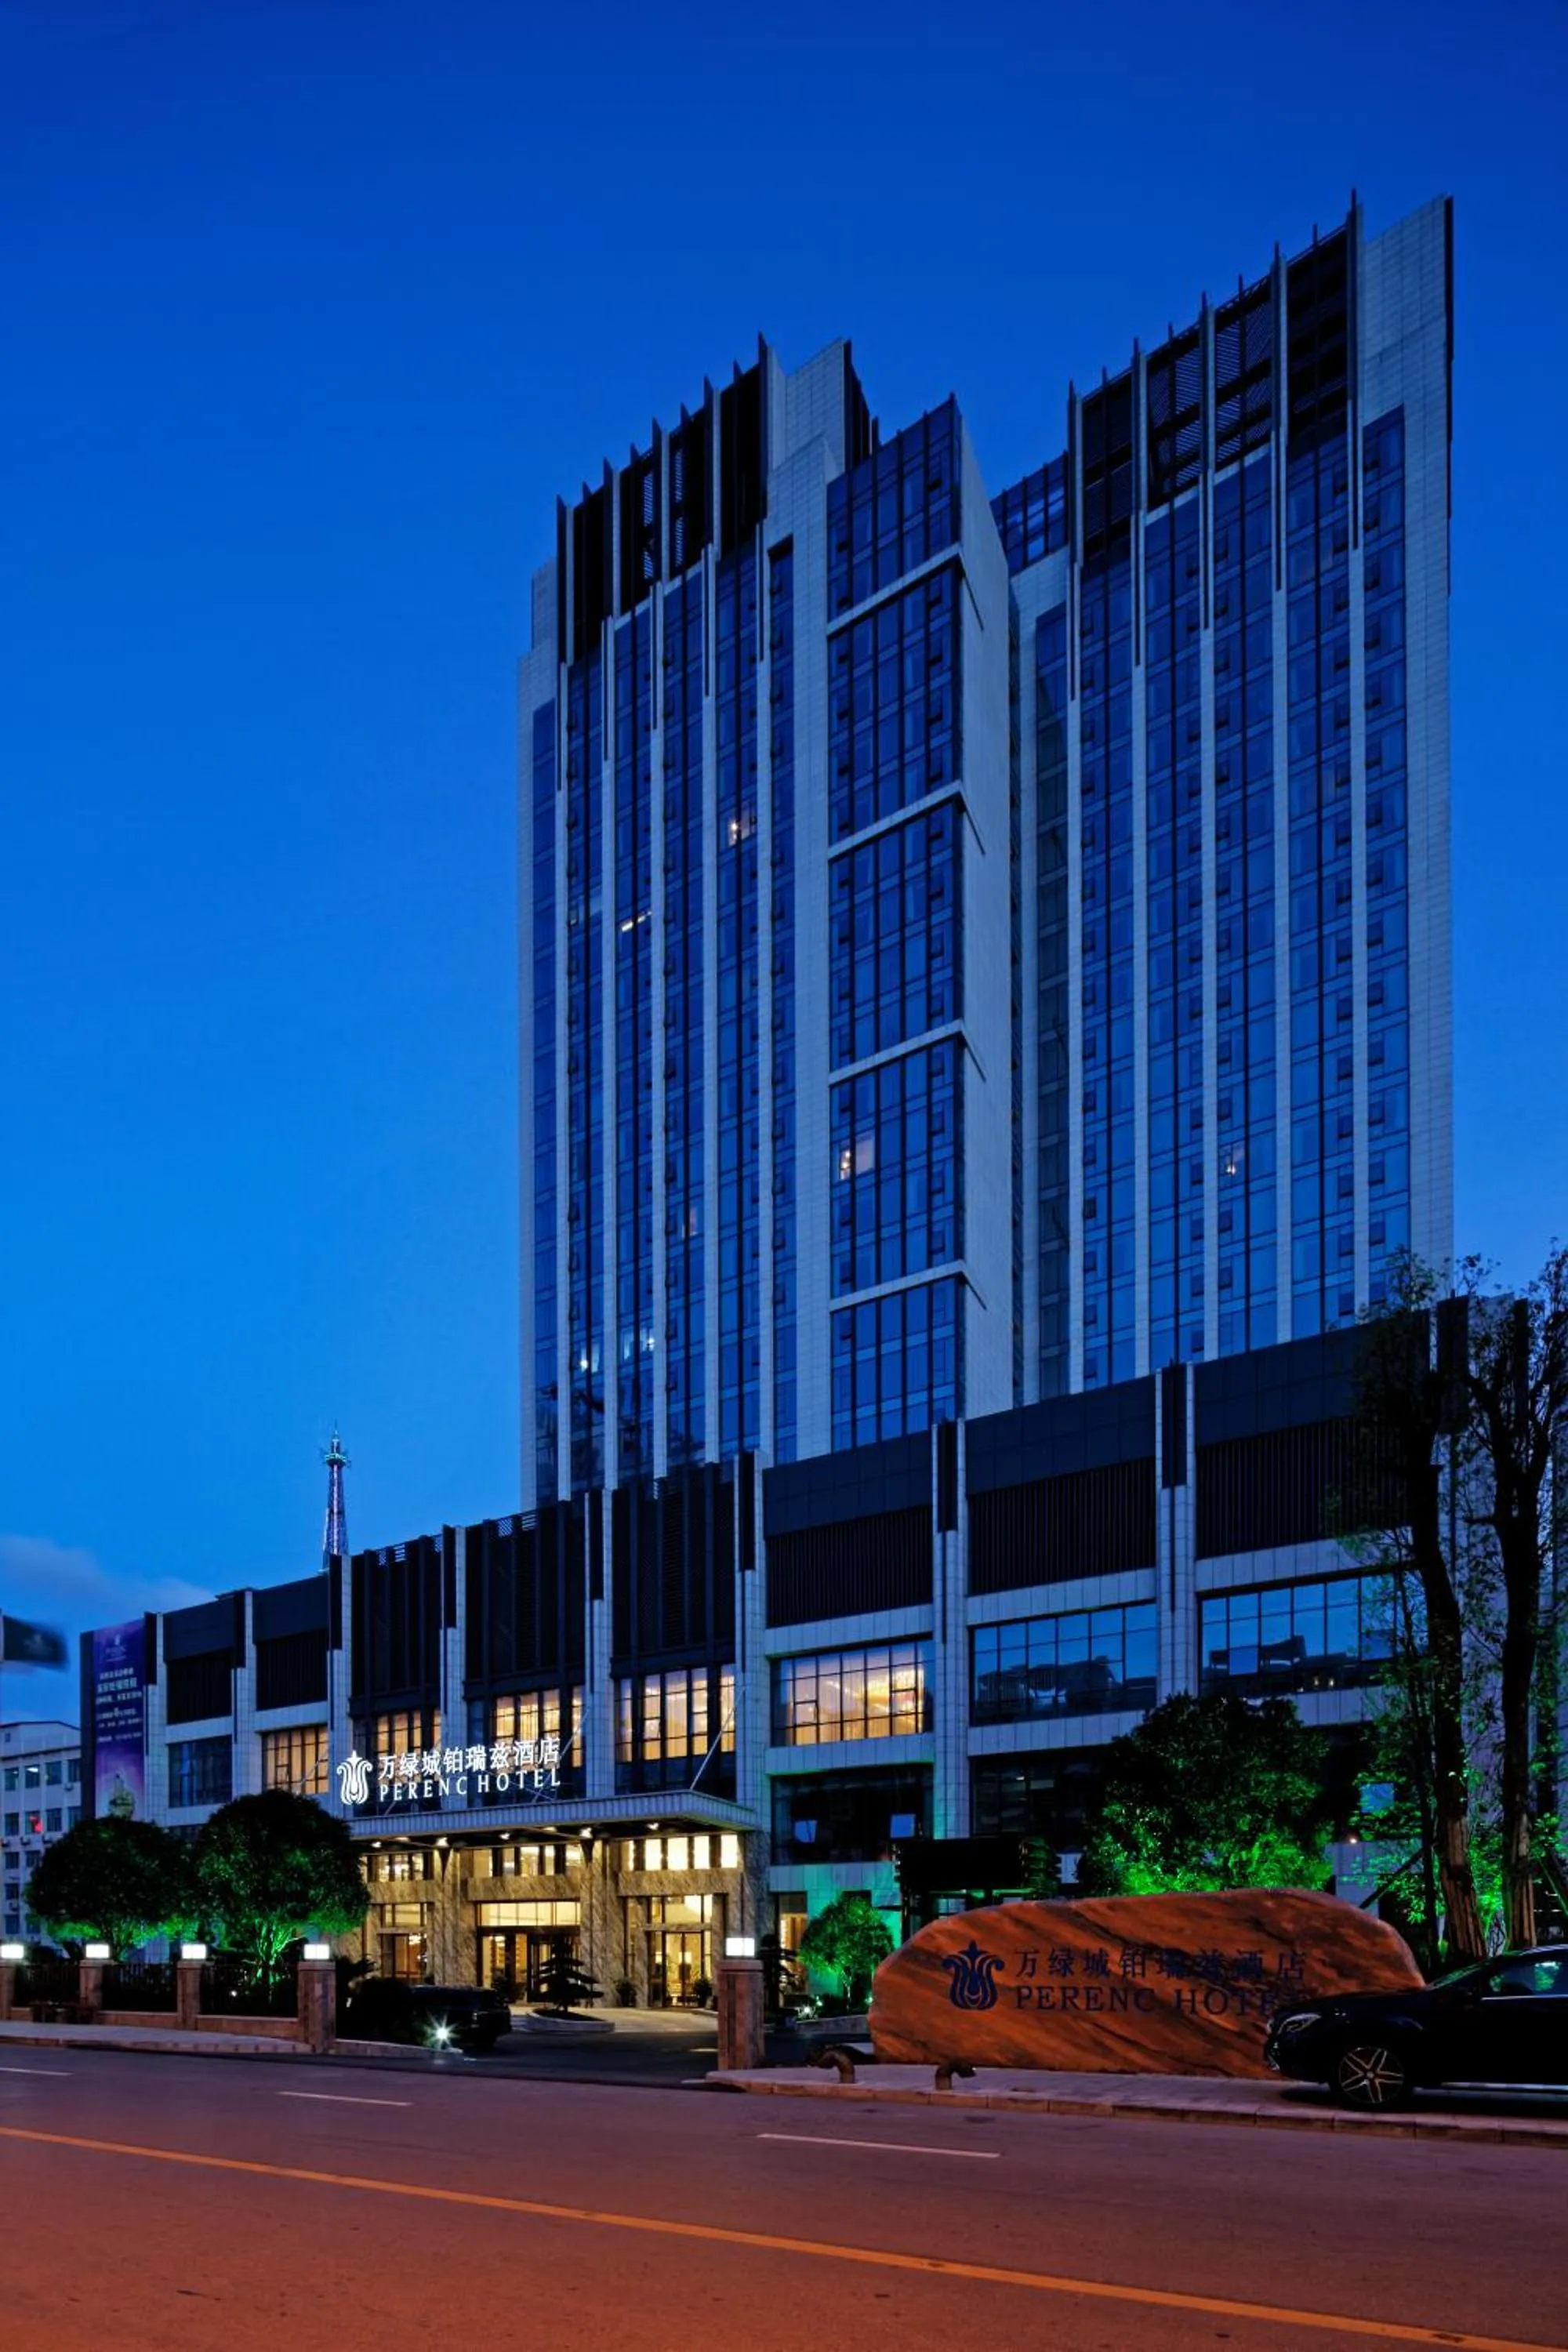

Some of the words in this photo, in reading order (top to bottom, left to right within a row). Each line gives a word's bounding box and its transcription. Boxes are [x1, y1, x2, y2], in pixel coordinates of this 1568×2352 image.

[378, 1737, 561, 1780] 万绿城铂瑞兹酒店
[379, 1776, 468, 1802] PERENC
[477, 1768, 561, 1794] HOTEL
[1015, 1985, 1156, 2012] PERENC
[1174, 1988, 1294, 2016] HOTE
